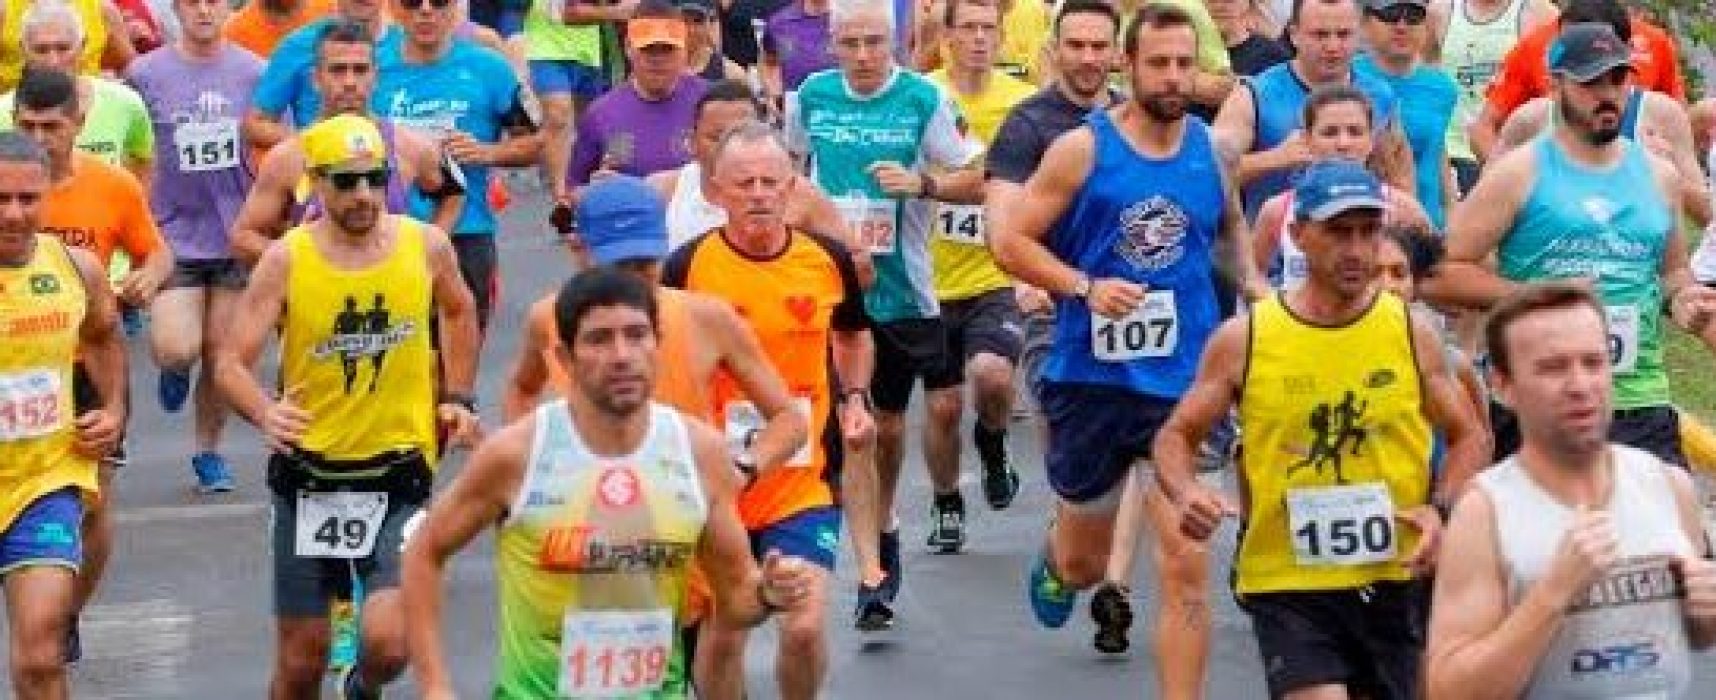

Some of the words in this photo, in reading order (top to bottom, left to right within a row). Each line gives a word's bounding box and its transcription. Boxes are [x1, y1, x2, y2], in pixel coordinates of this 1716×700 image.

[183, 139, 234, 165] 151
[1098, 318, 1174, 353] 107
[313, 516, 366, 550] 49
[1296, 514, 1392, 556] 150
[567, 643, 666, 689] 1139
